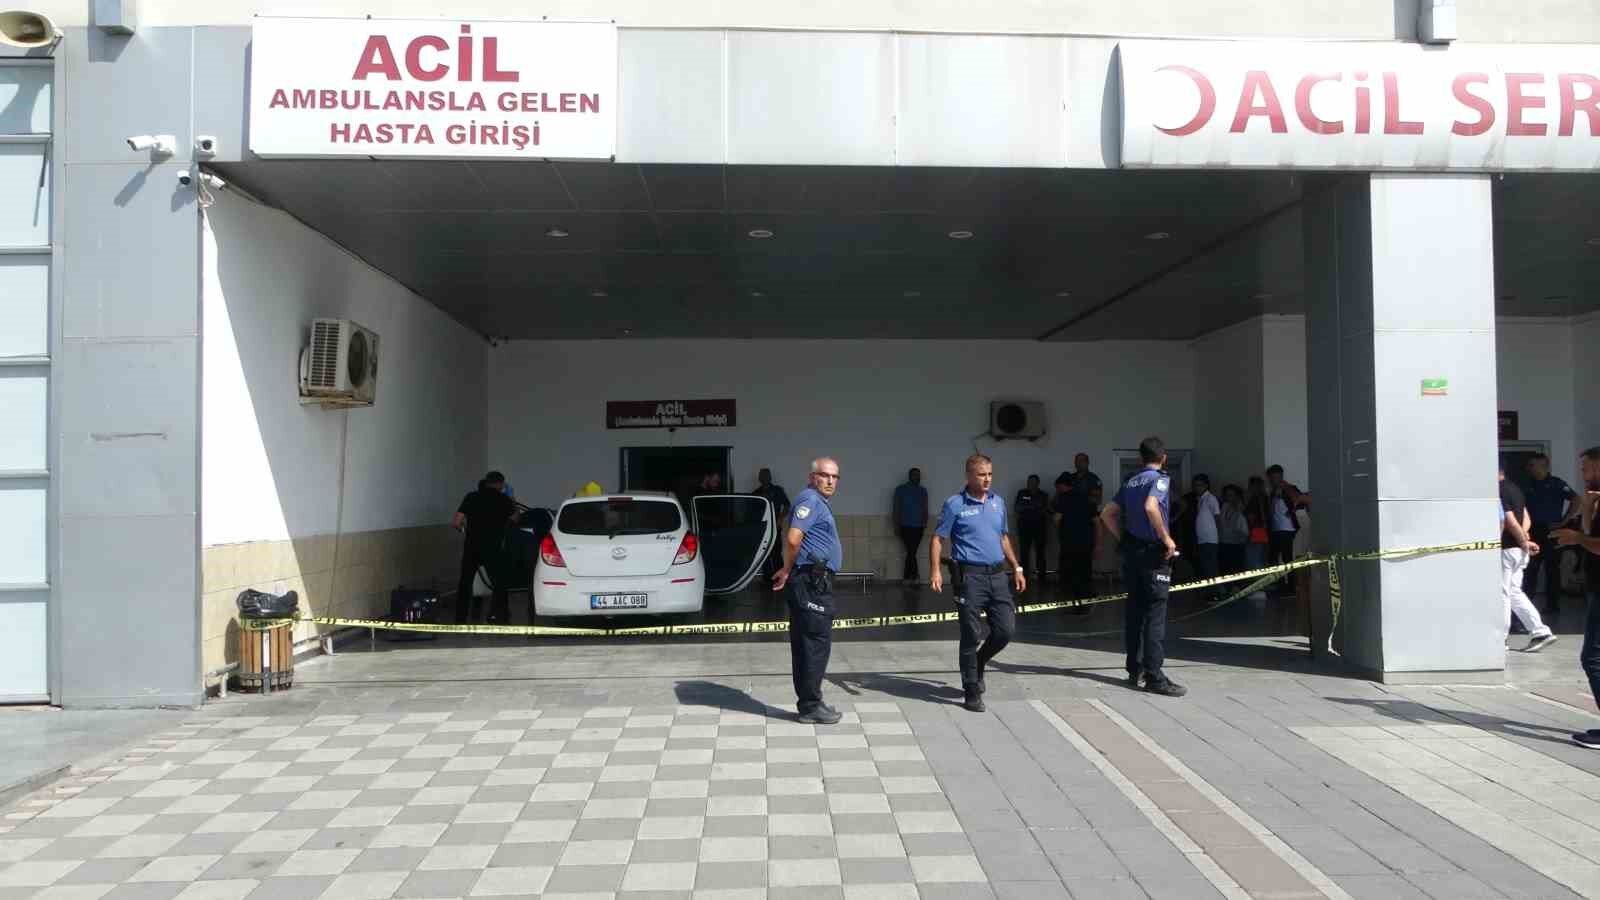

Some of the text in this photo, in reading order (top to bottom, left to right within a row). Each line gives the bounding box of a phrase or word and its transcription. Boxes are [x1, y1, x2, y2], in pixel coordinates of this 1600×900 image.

[352, 24, 520, 82] ACİL
[268, 89, 600, 113] AMBULANSLA GELEN
[330, 120, 541, 150] HASTA GİRİŞİ
[757, 623, 791, 632] OLIS
